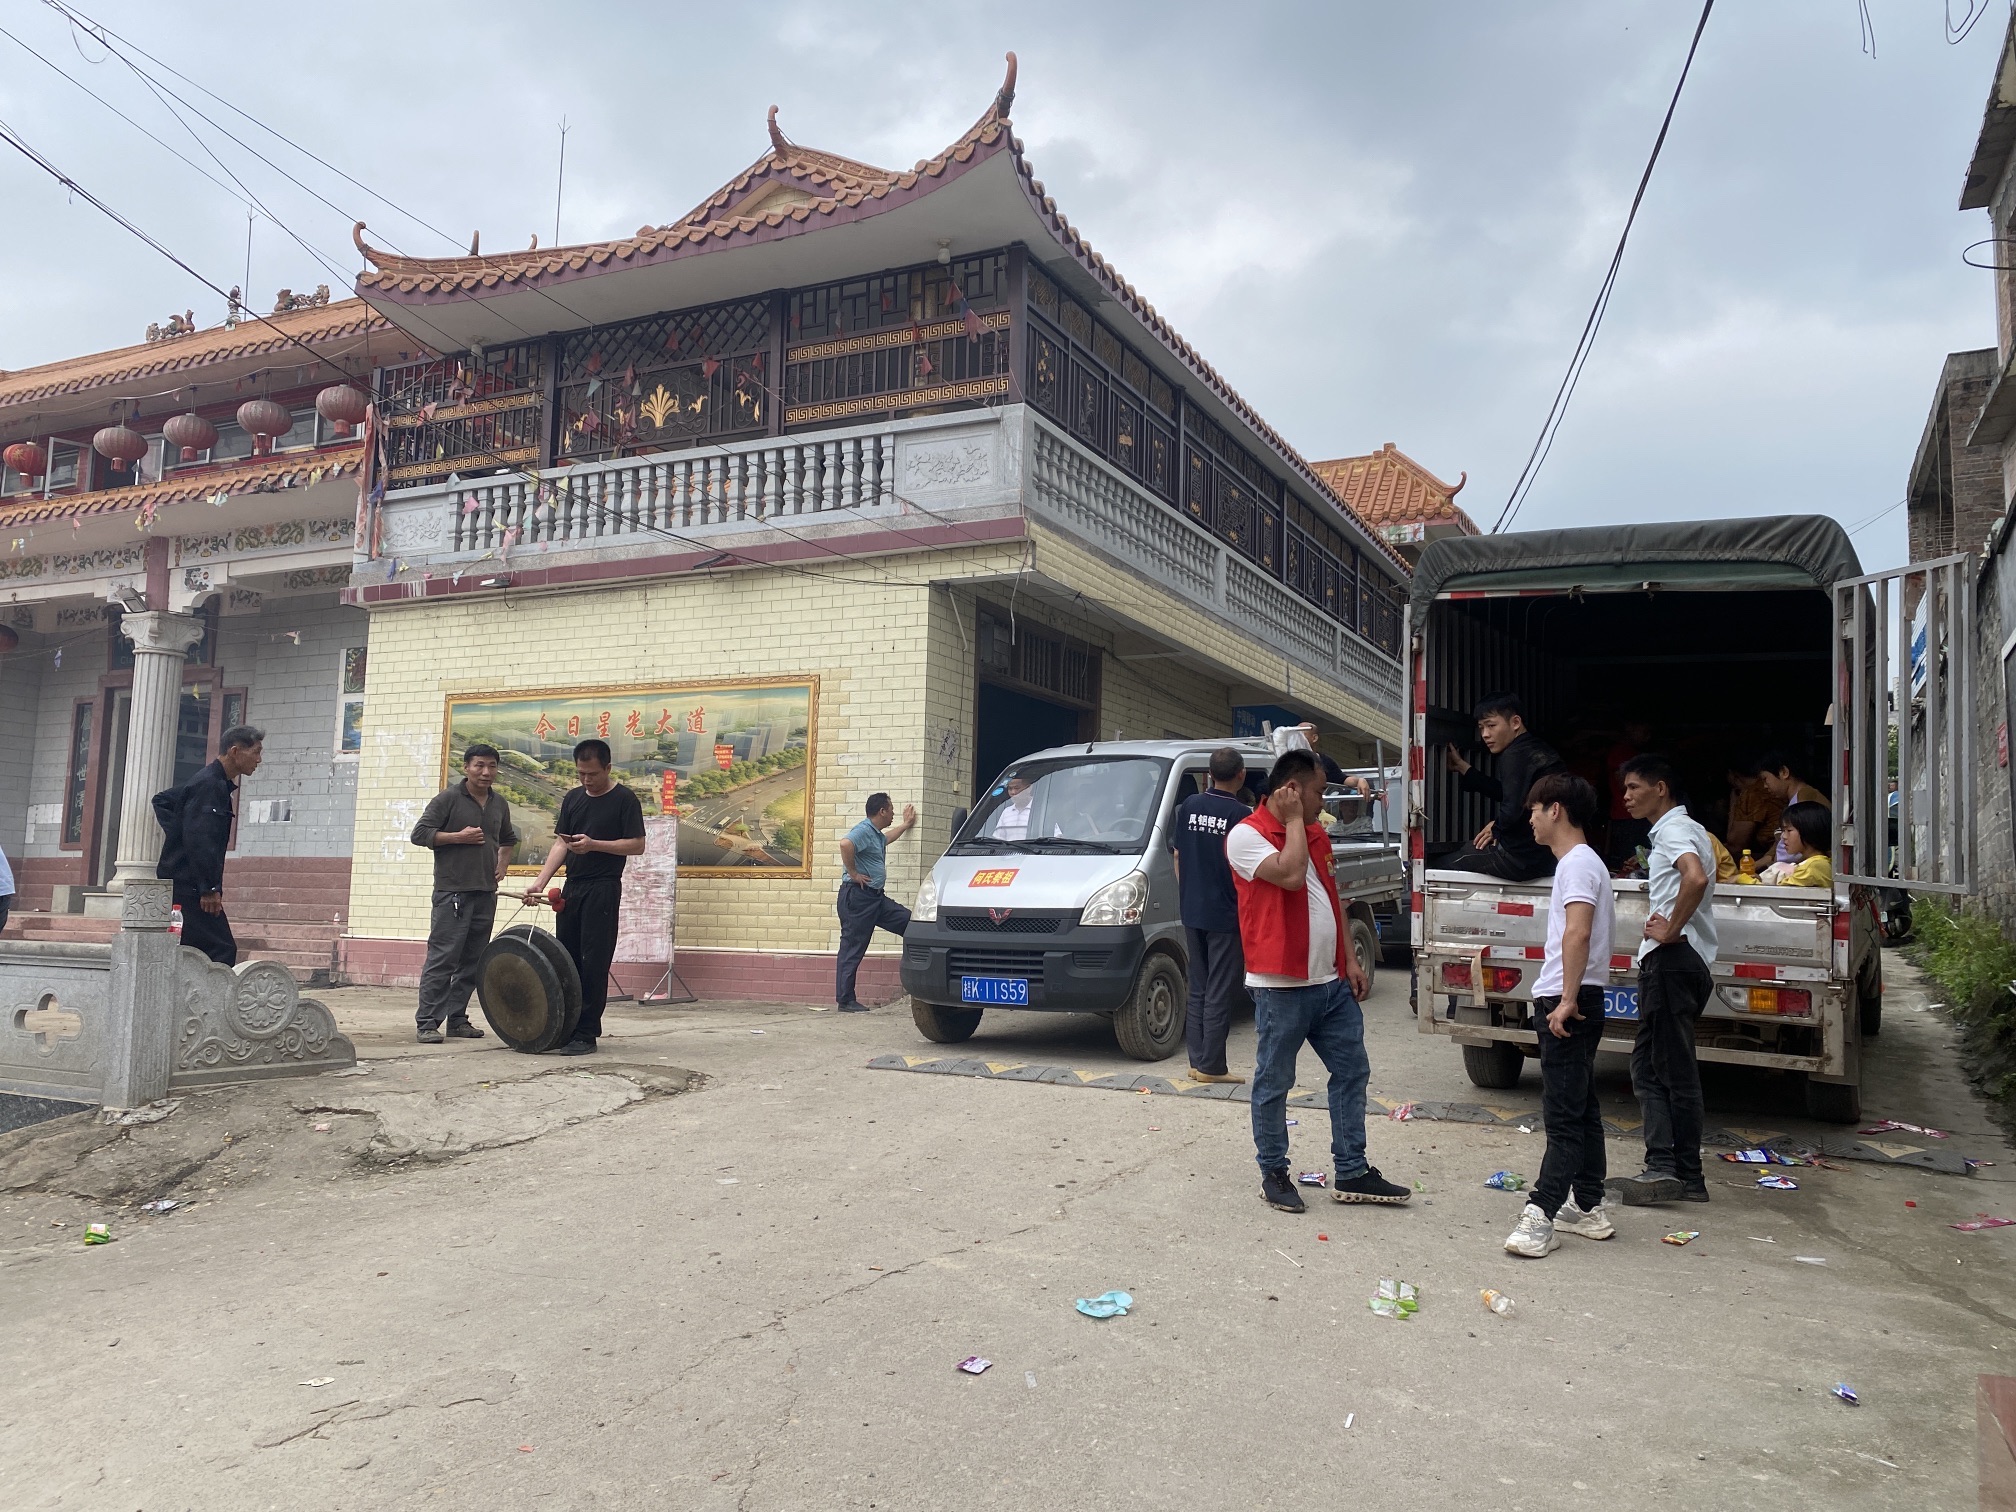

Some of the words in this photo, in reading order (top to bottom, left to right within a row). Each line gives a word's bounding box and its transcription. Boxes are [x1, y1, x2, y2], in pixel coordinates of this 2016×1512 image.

[533, 706, 708, 740] 今日星光大道
[972, 871, 1015, 885] 何氏祭祖
